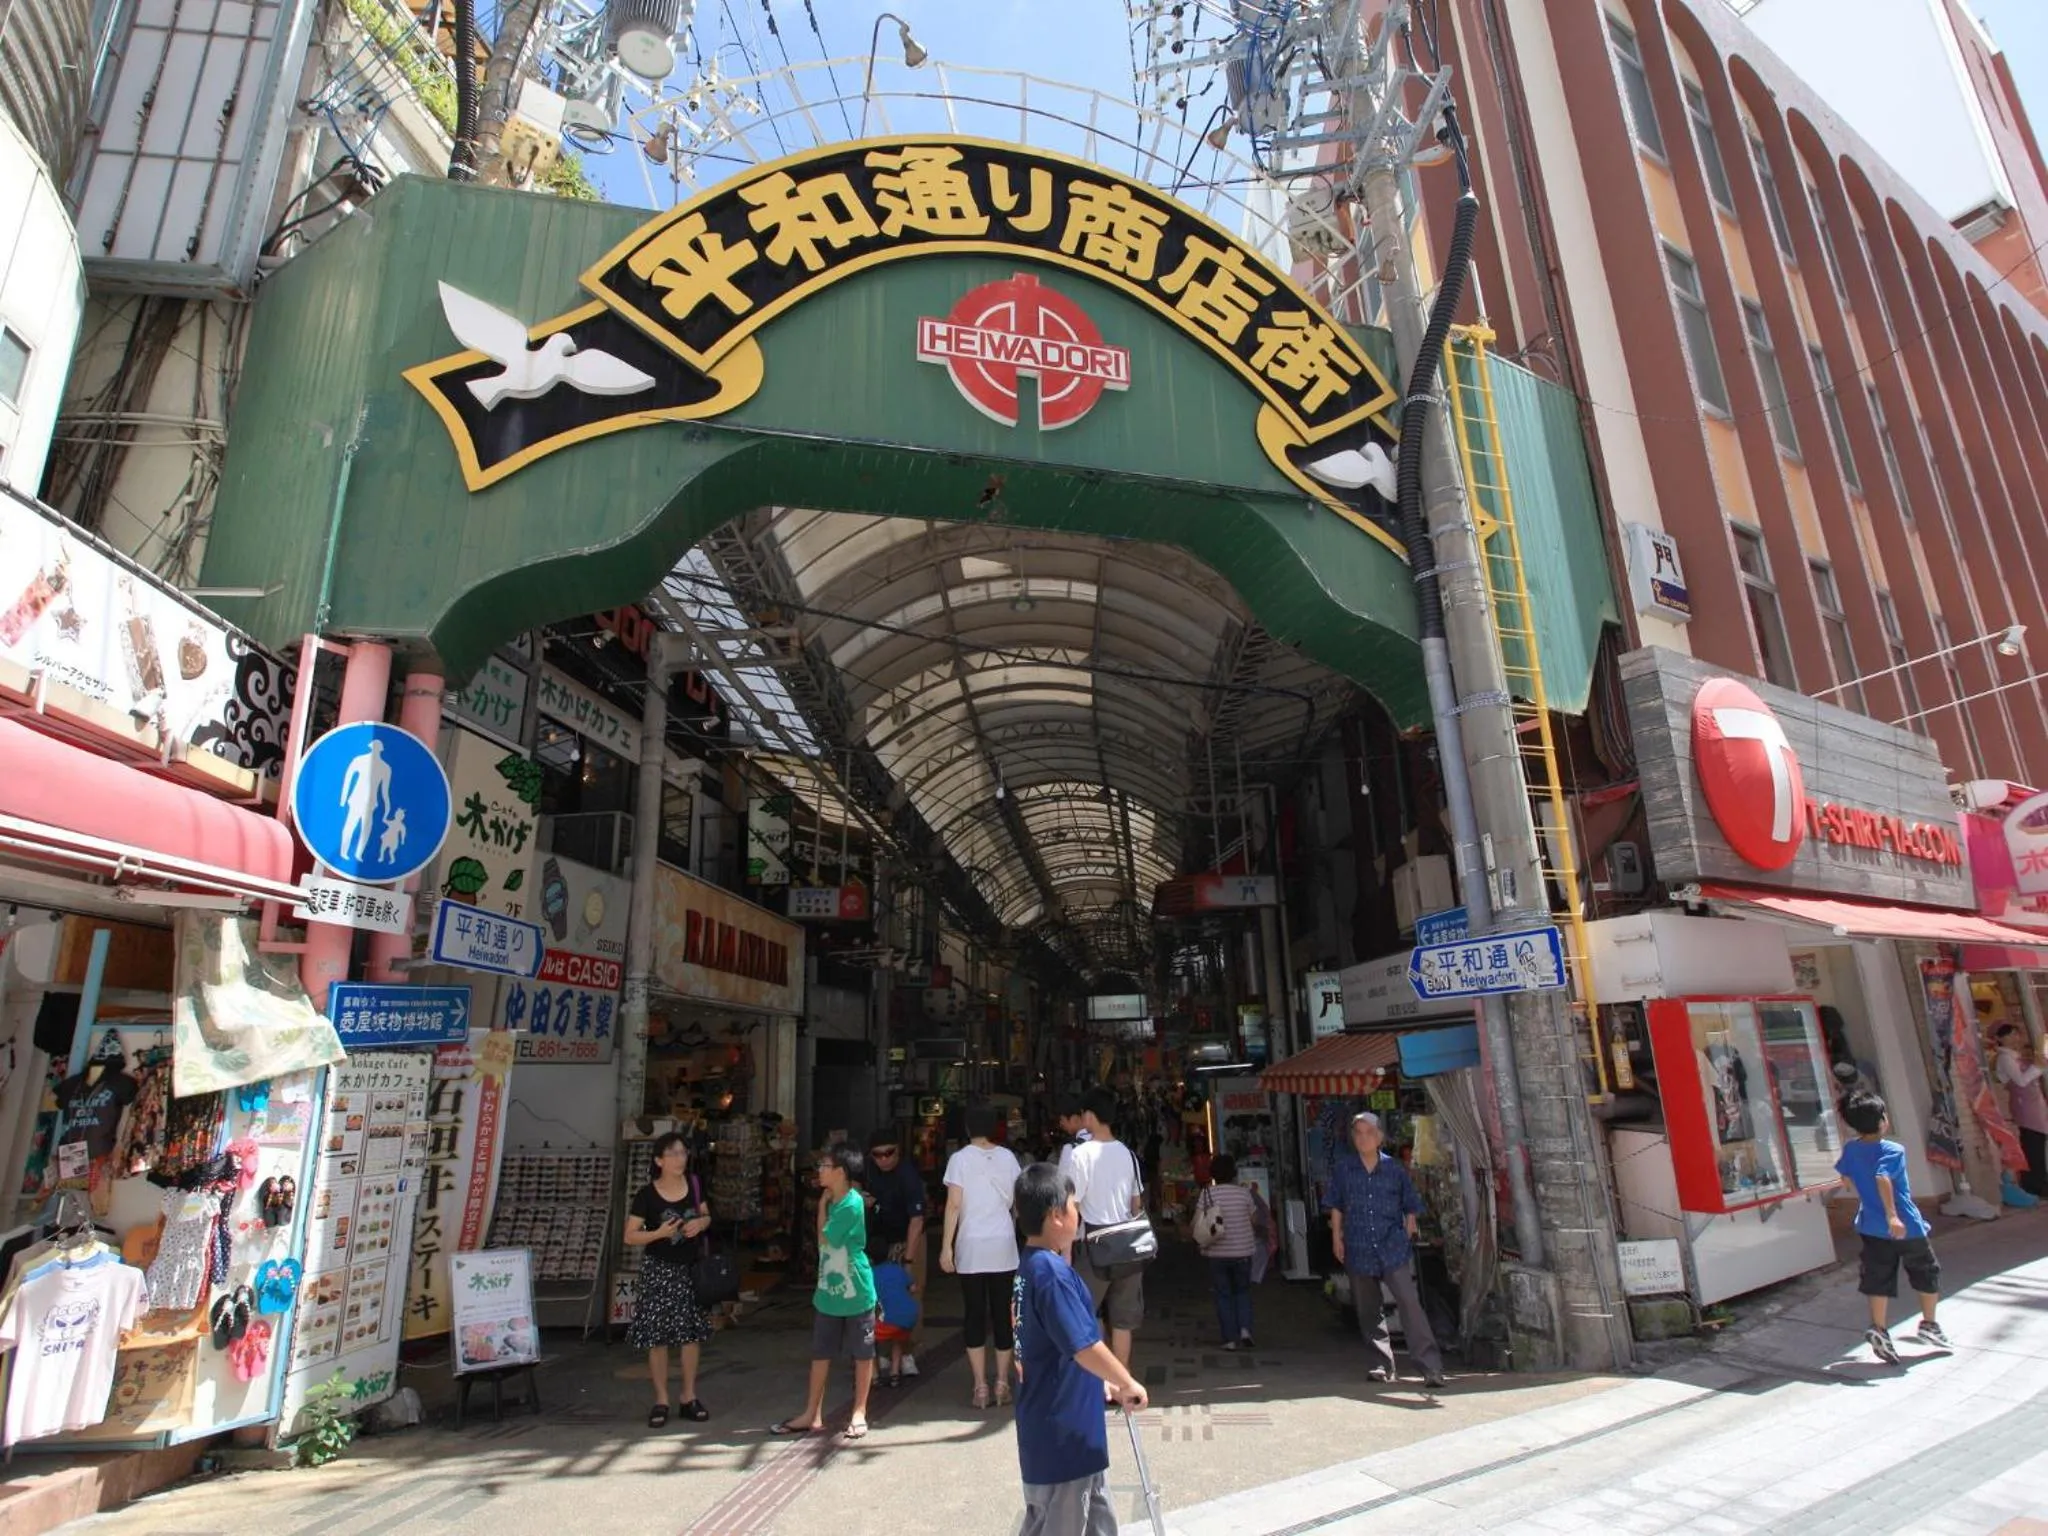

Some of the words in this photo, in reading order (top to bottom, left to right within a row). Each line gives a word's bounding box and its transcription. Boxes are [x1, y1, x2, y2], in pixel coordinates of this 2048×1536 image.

[628, 146, 1362, 414] 平和通り商店街
[929, 323, 1128, 380] HEIWADORI
[456, 791, 533, 854] 木かげ
[1805, 796, 1961, 865] T-SHIRT-YA.COM
[456, 913, 524, 952] 平和通り
[468, 944, 509, 964] Heiwadori
[1437, 940, 1534, 972] 平和通り
[567, 957, 619, 989] CASIO
[1460, 969, 1517, 988] Heiwadori
[339, 1073, 413, 1089] 木かげカフェ
